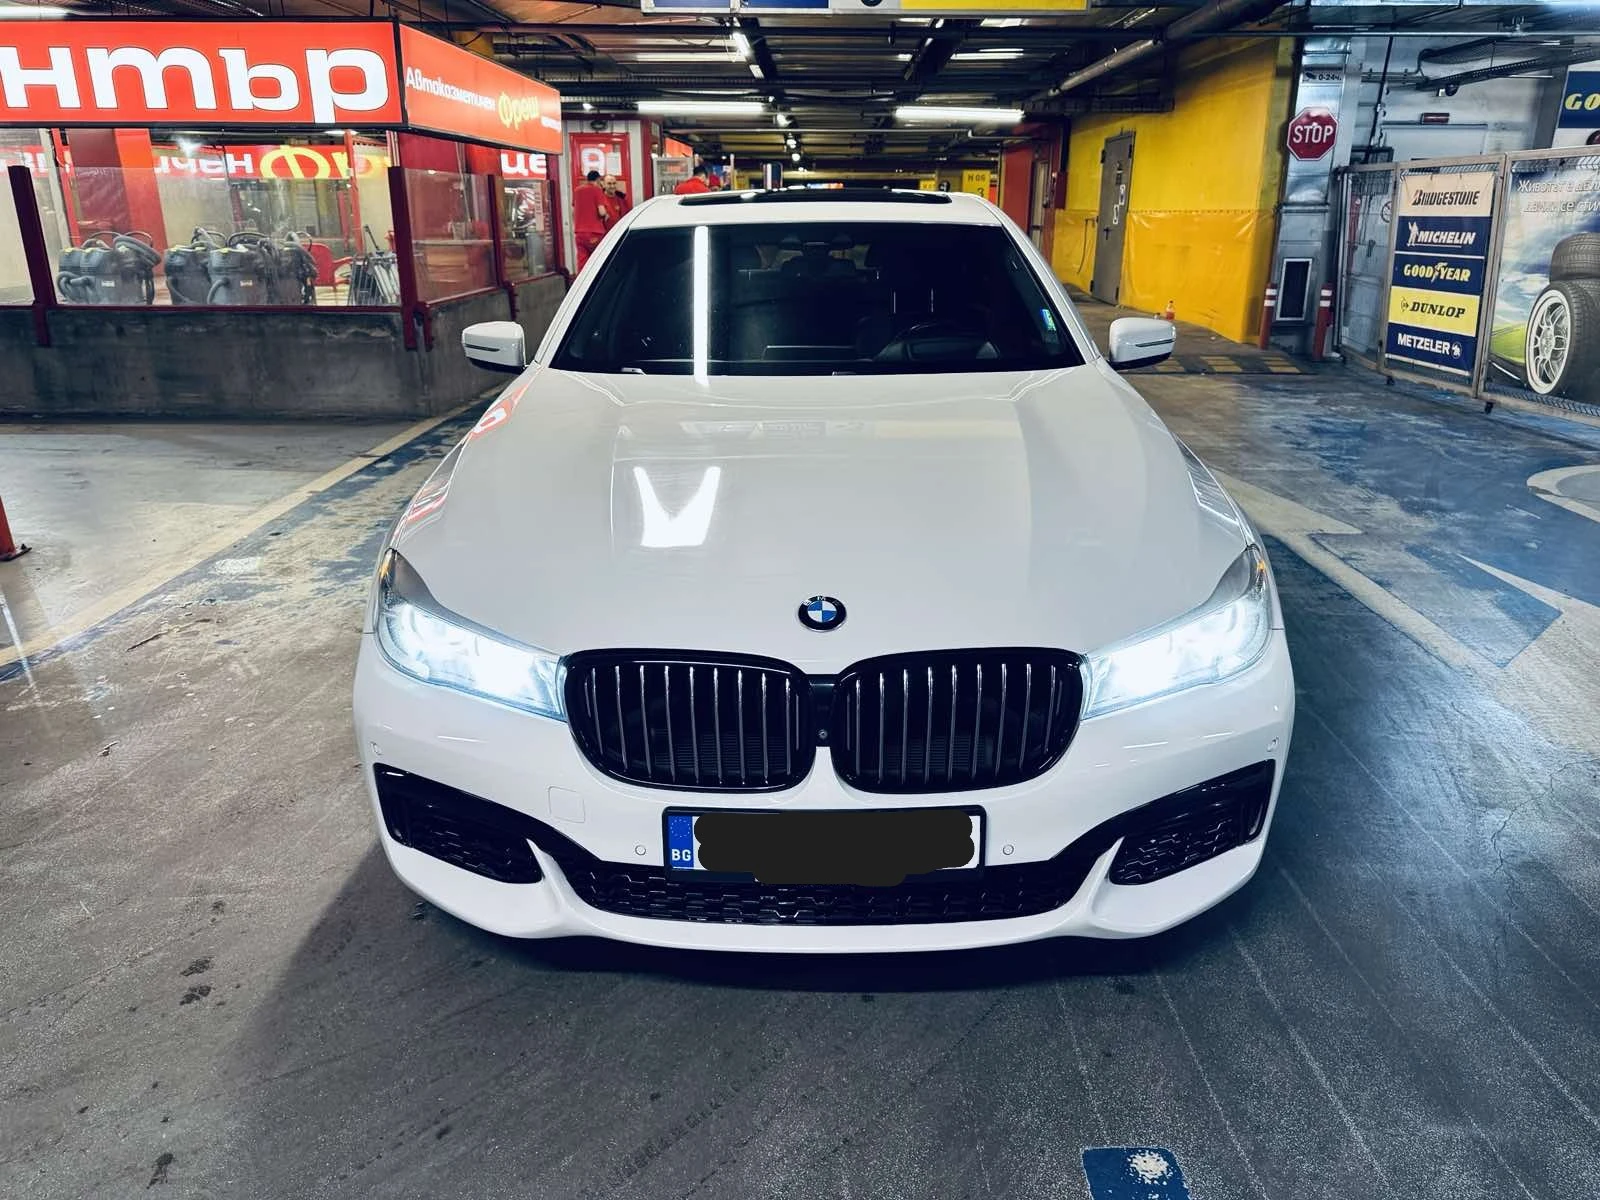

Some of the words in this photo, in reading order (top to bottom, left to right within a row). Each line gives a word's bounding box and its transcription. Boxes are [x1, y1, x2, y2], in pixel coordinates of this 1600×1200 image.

[1293, 124, 1334, 144] STOP
[1410, 190, 1480, 206] BRIDGESTONE
[1417, 231, 1476, 245] MICHELIN
[1403, 262, 1471, 283] GOODYEAR
[1410, 301, 1466, 318] DUNLOP
[1397, 332, 1451, 355] METZELER
[671, 848, 692, 861] BG
